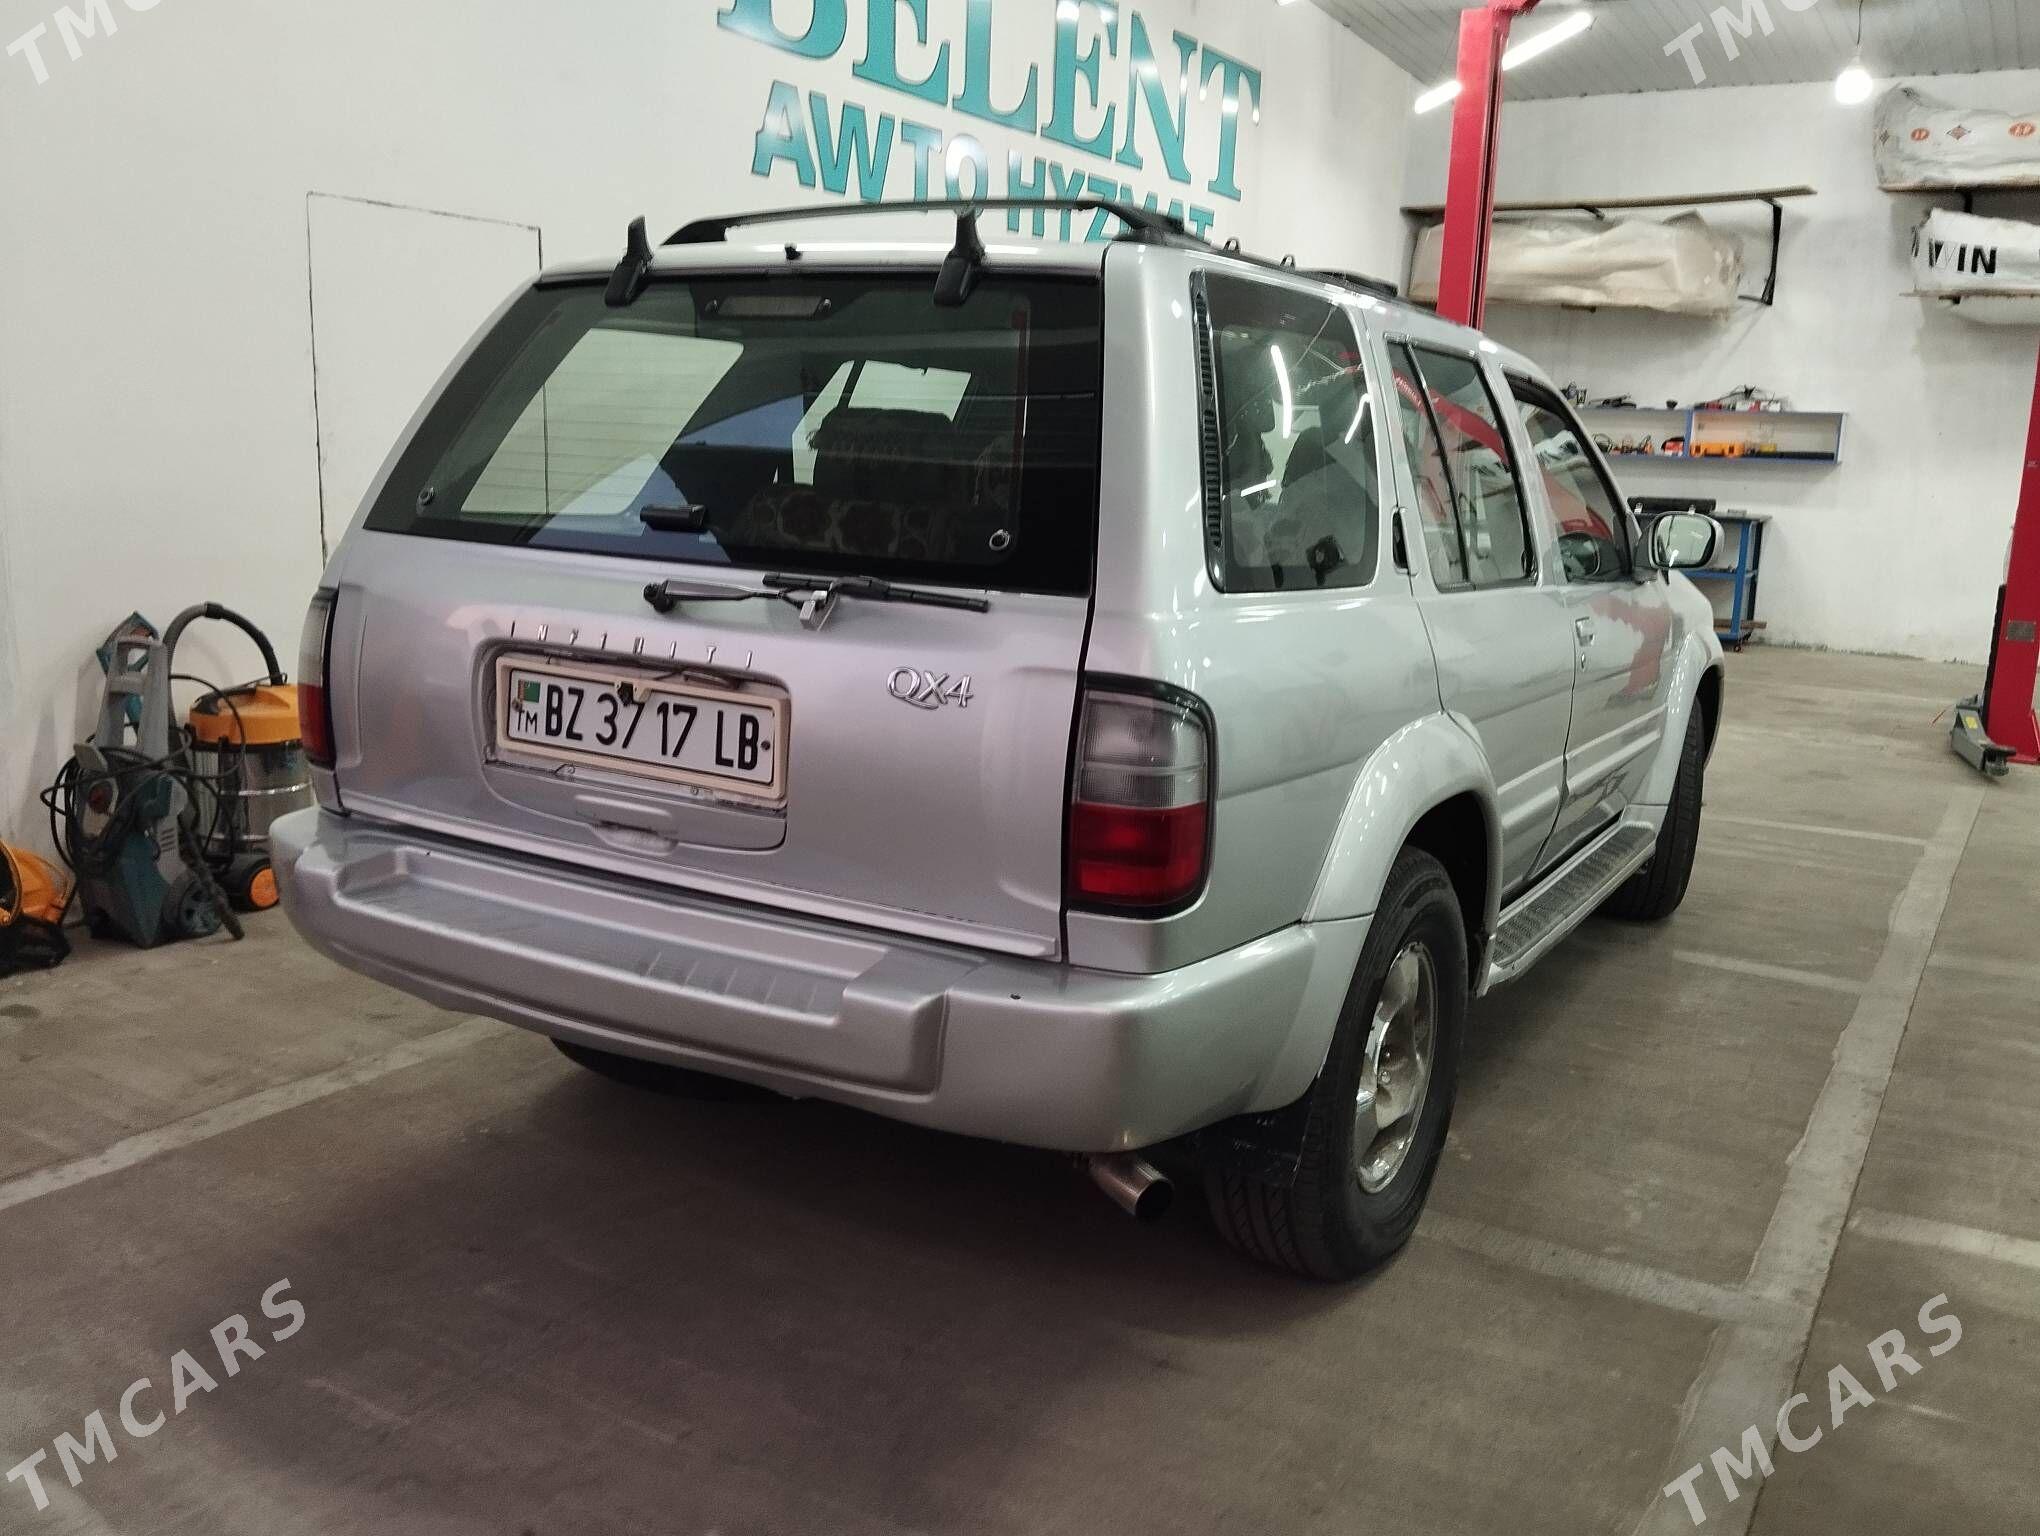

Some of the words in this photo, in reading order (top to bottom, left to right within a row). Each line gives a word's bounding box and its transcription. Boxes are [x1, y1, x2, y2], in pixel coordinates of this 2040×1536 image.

[717, 0, 1261, 200] ELENT
[751, 79, 989, 217] AWTO
[514, 707, 538, 735] TM
[545, 683, 584, 741] BZ
[714, 709, 760, 771] LB
[887, 666, 974, 710] QX4
